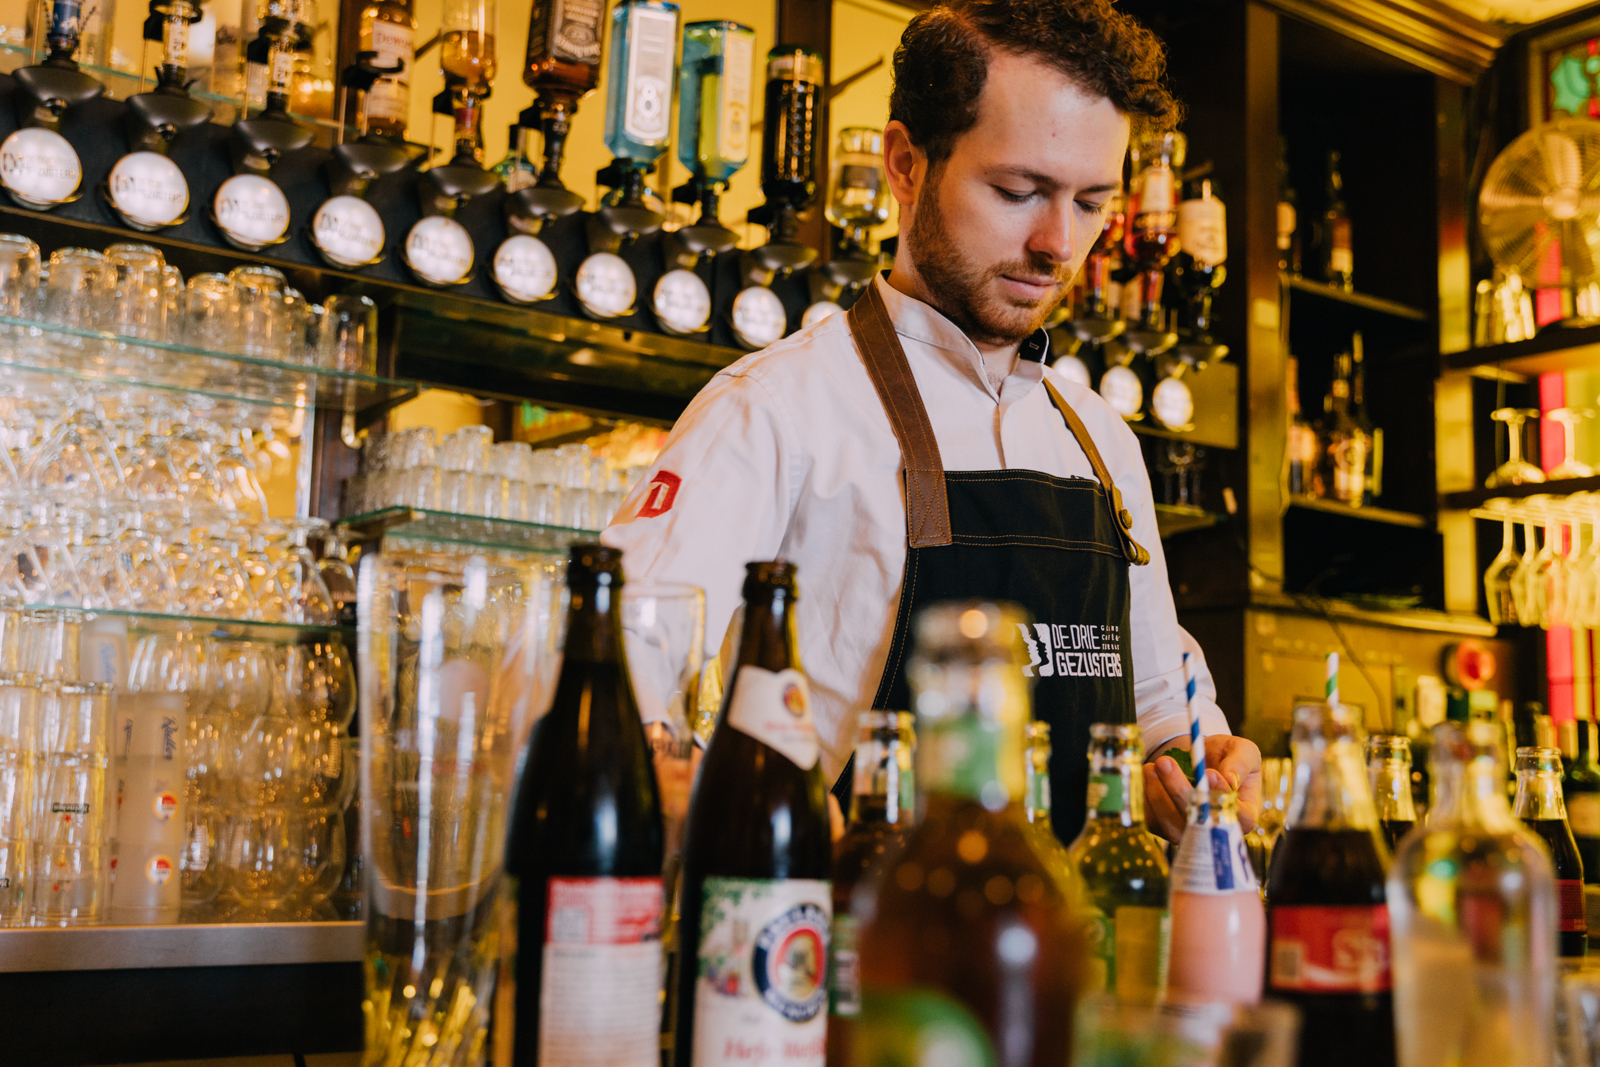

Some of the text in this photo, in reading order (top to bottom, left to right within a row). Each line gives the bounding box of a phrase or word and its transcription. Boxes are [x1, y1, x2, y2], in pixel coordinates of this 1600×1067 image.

[1051, 623, 1101, 650] DE DRIE
[1056, 652, 1122, 678] GEZUSTERS
